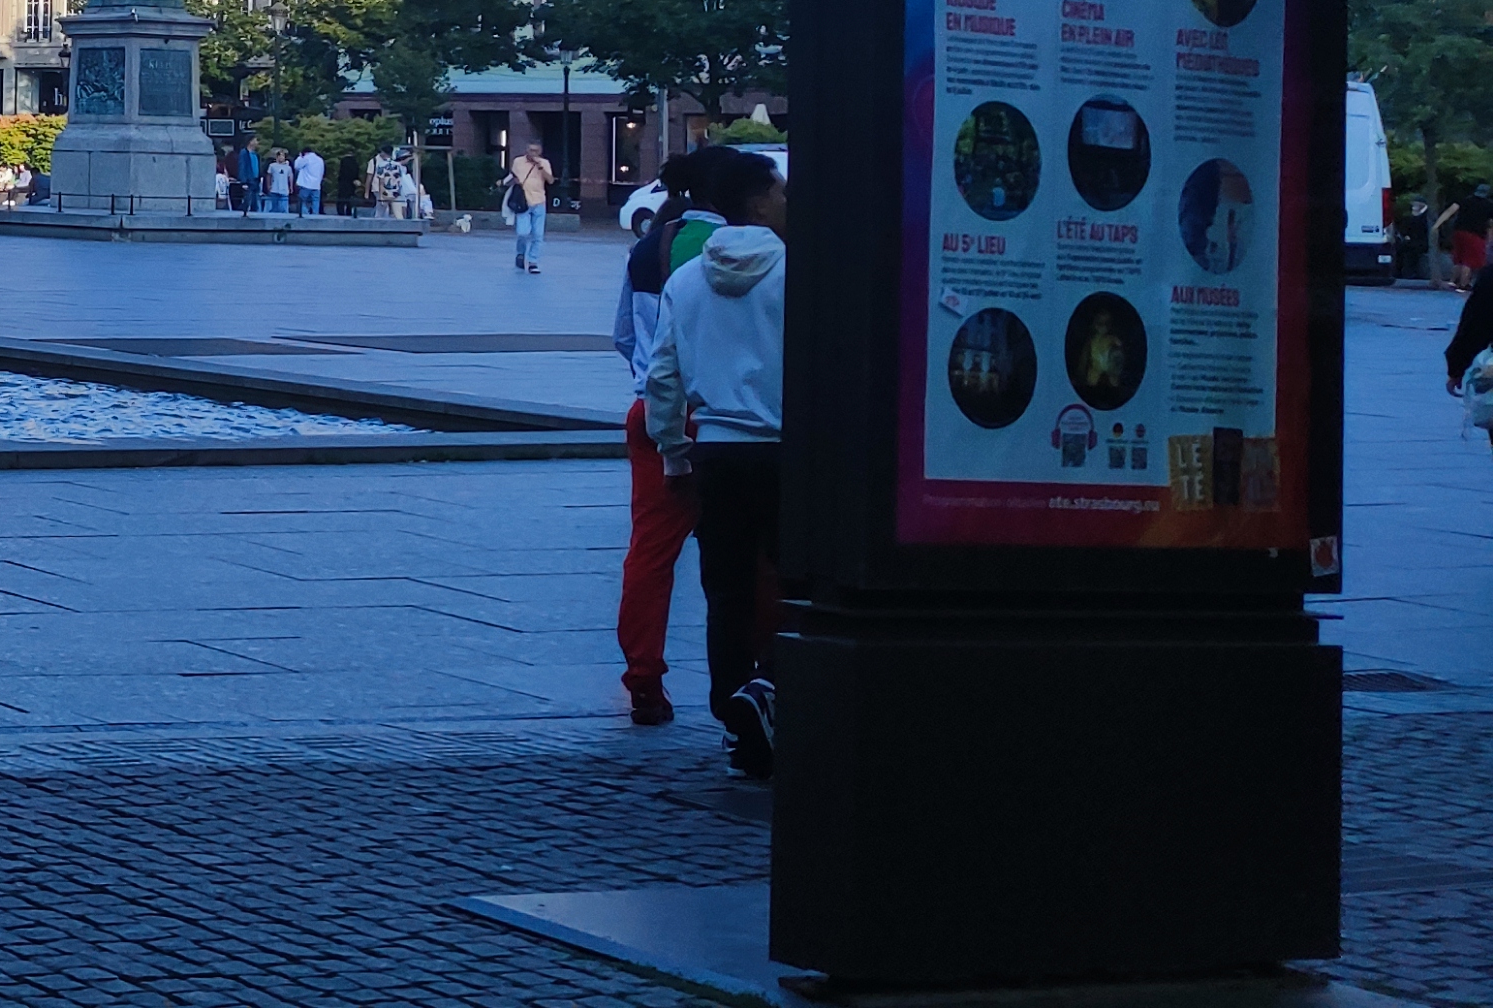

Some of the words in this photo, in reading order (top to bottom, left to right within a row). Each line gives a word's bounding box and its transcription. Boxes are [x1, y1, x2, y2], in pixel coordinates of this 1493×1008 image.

[946, 12, 961, 31] EN
[942, 233, 959, 252] AU
[977, 234, 1006, 255] LIEU
[1089, 222, 1105, 241] AU
[1105, 223, 1138, 244] TAPS
